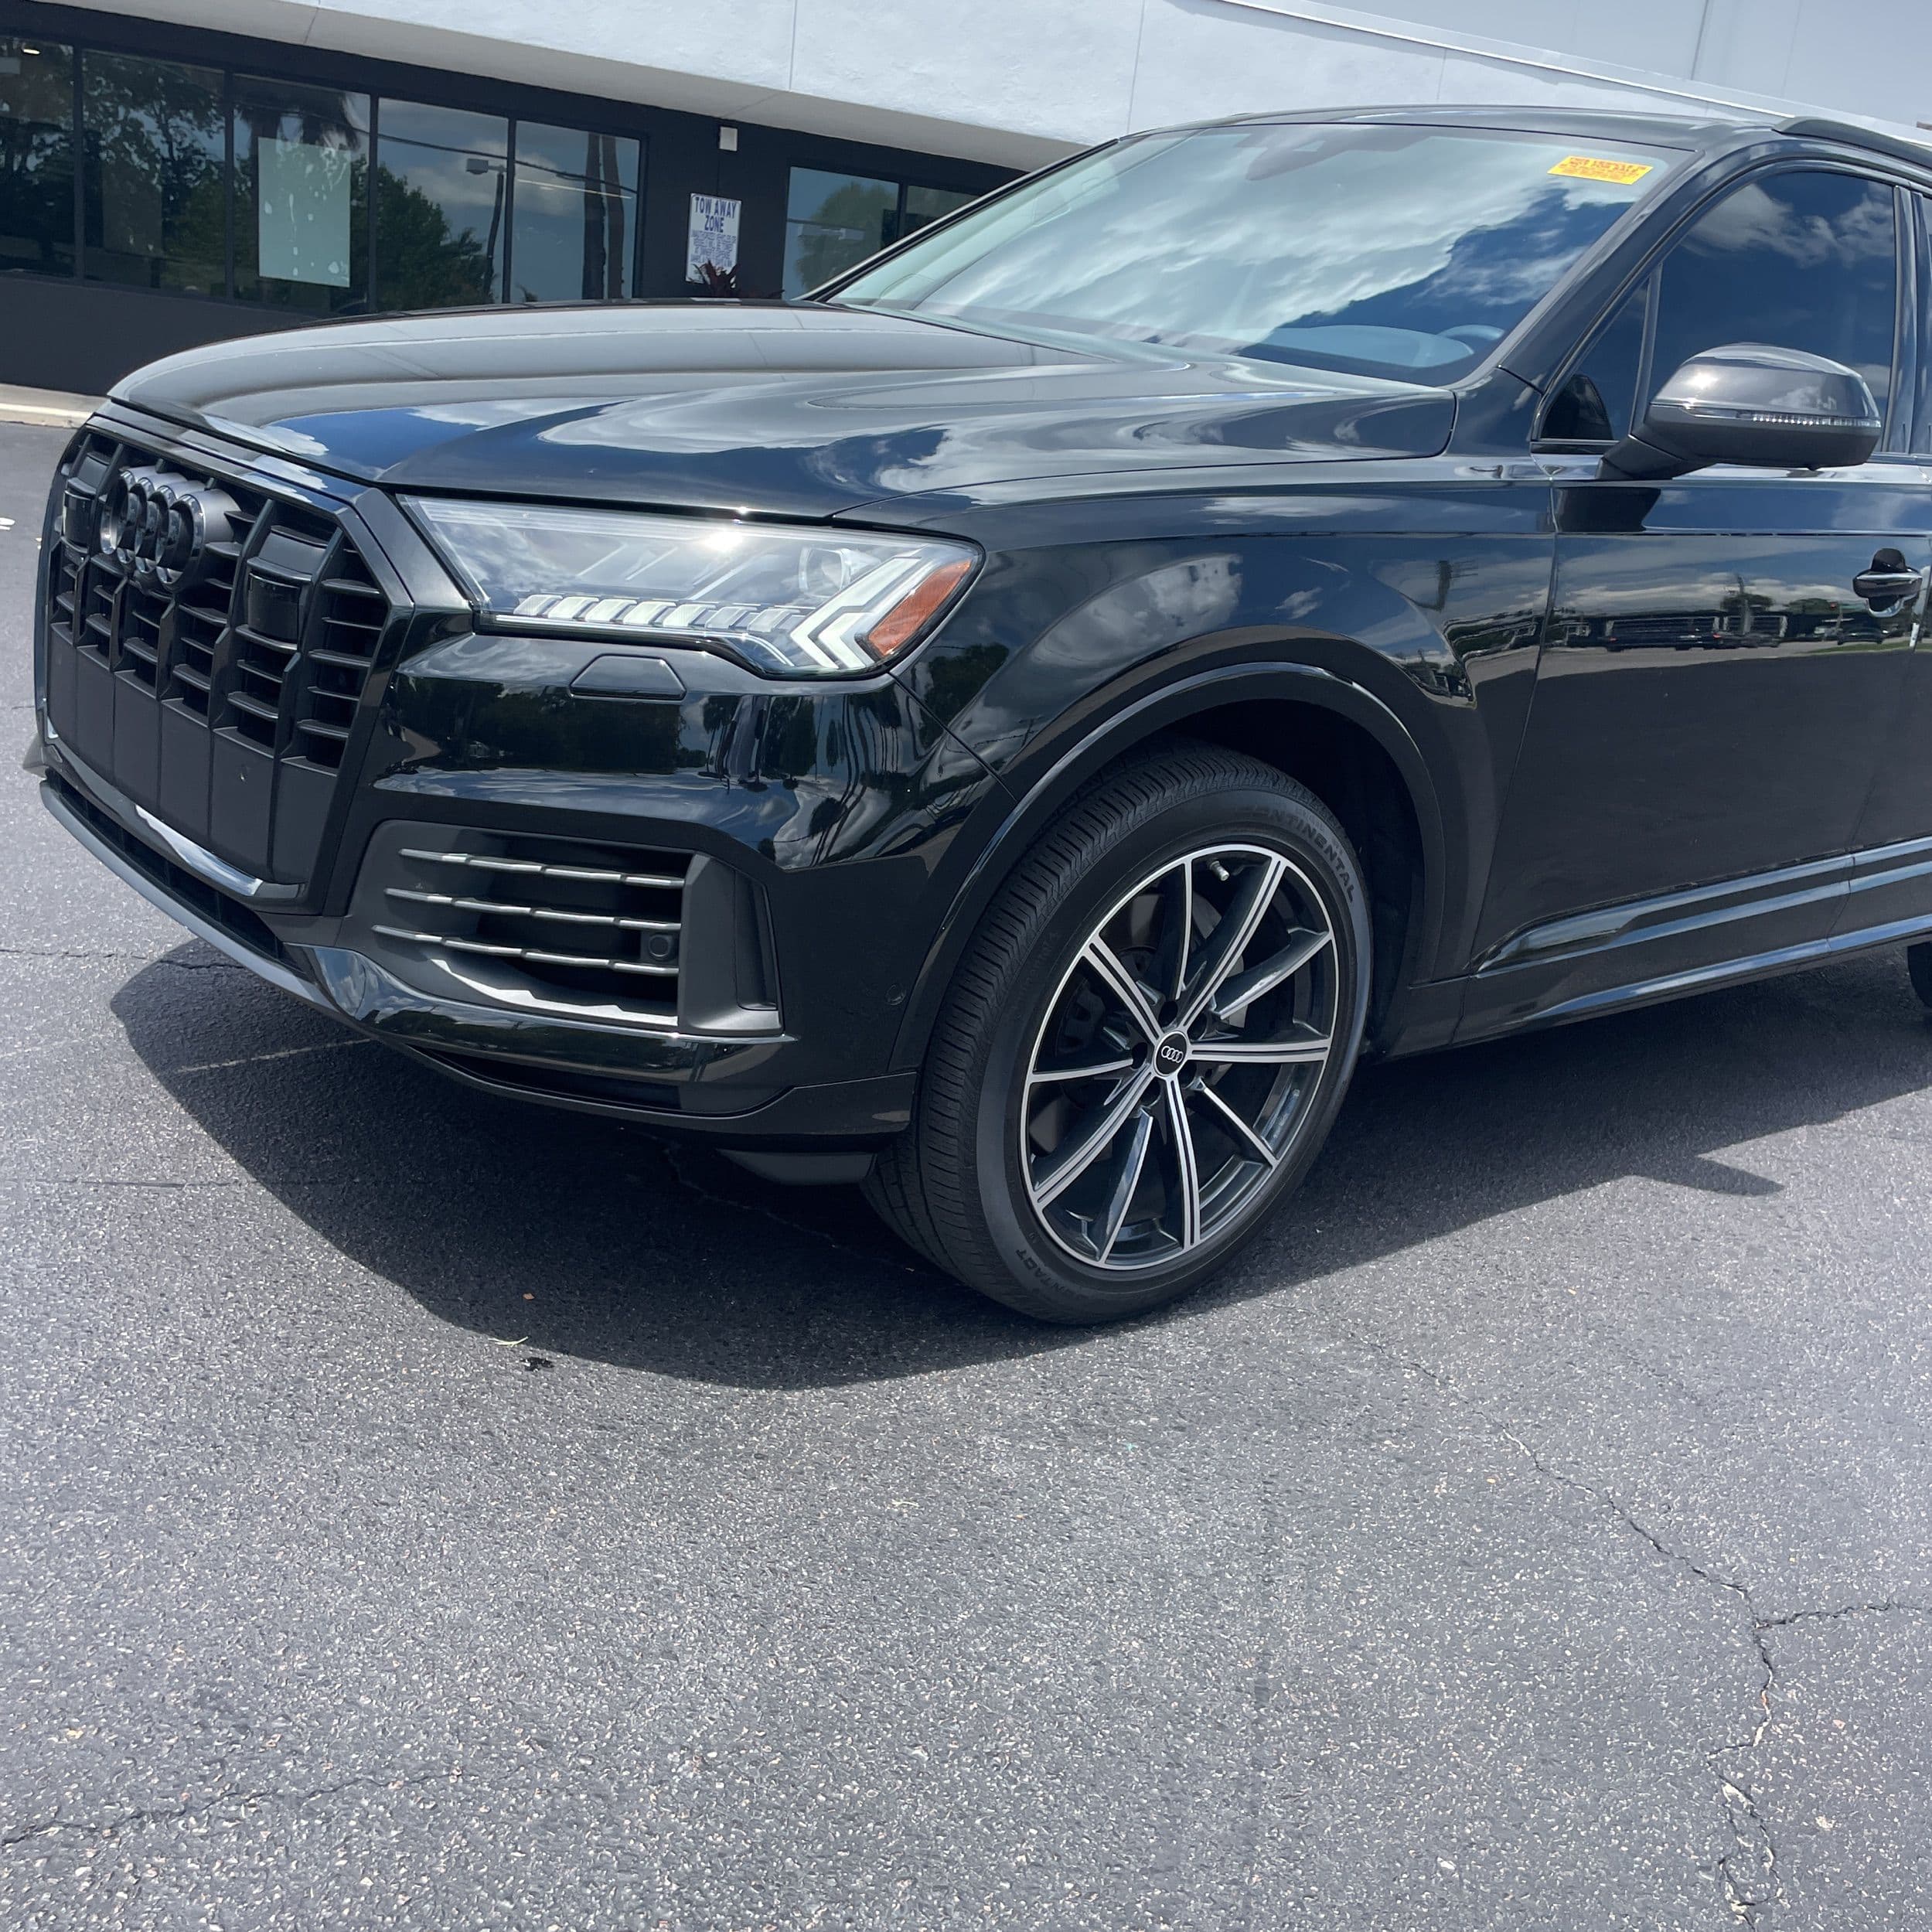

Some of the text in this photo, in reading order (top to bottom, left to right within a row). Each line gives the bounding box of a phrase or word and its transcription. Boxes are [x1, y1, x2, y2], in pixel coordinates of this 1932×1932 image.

[695, 196, 736, 219] TOW AWAY
[704, 215, 724, 233] ZONE
[1234, 804, 1354, 903] NTINENTAL
